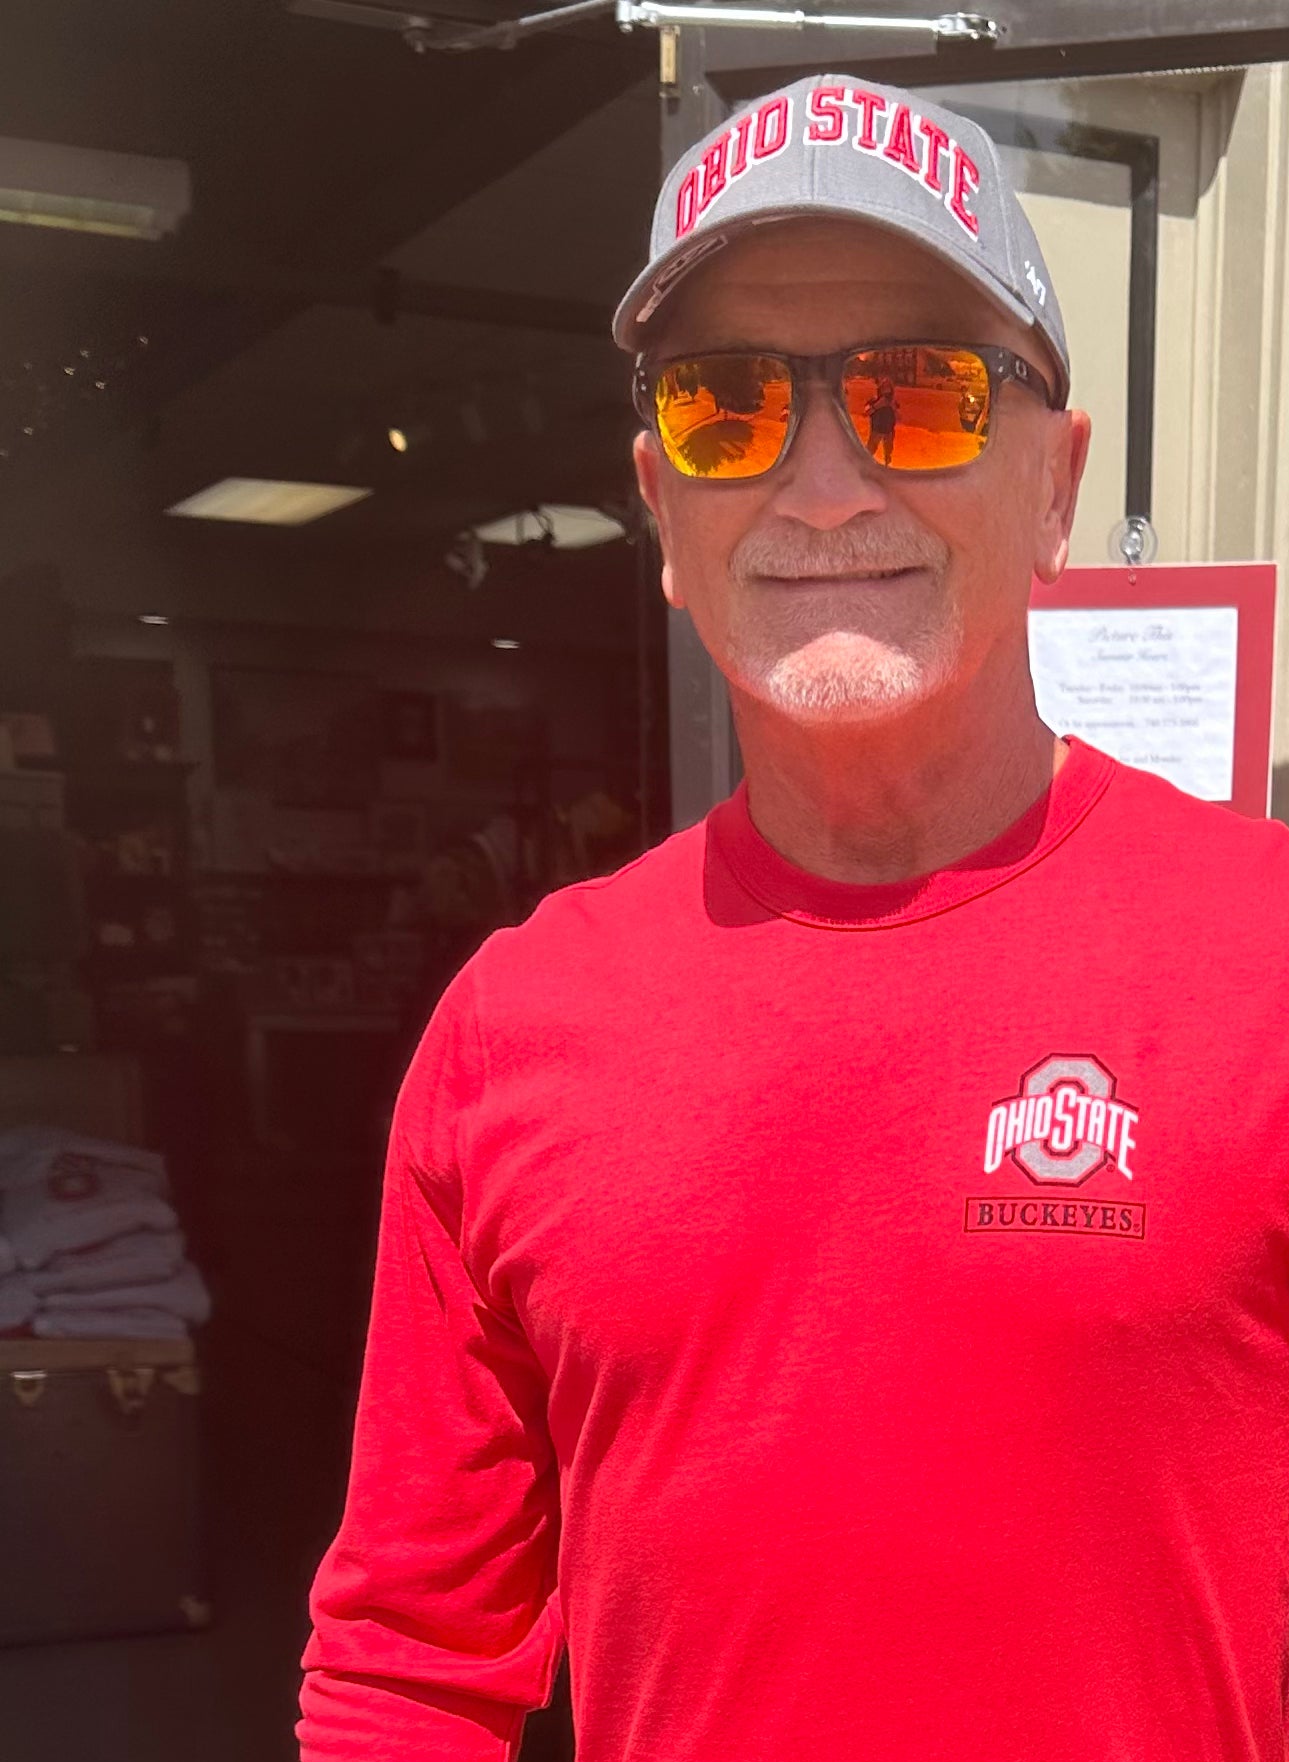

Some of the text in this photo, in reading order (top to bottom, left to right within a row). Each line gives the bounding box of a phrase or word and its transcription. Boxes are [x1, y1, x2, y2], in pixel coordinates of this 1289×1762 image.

[675, 85, 981, 241] OHIO STATE
[977, 1203, 1133, 1231] BUCKEYES
